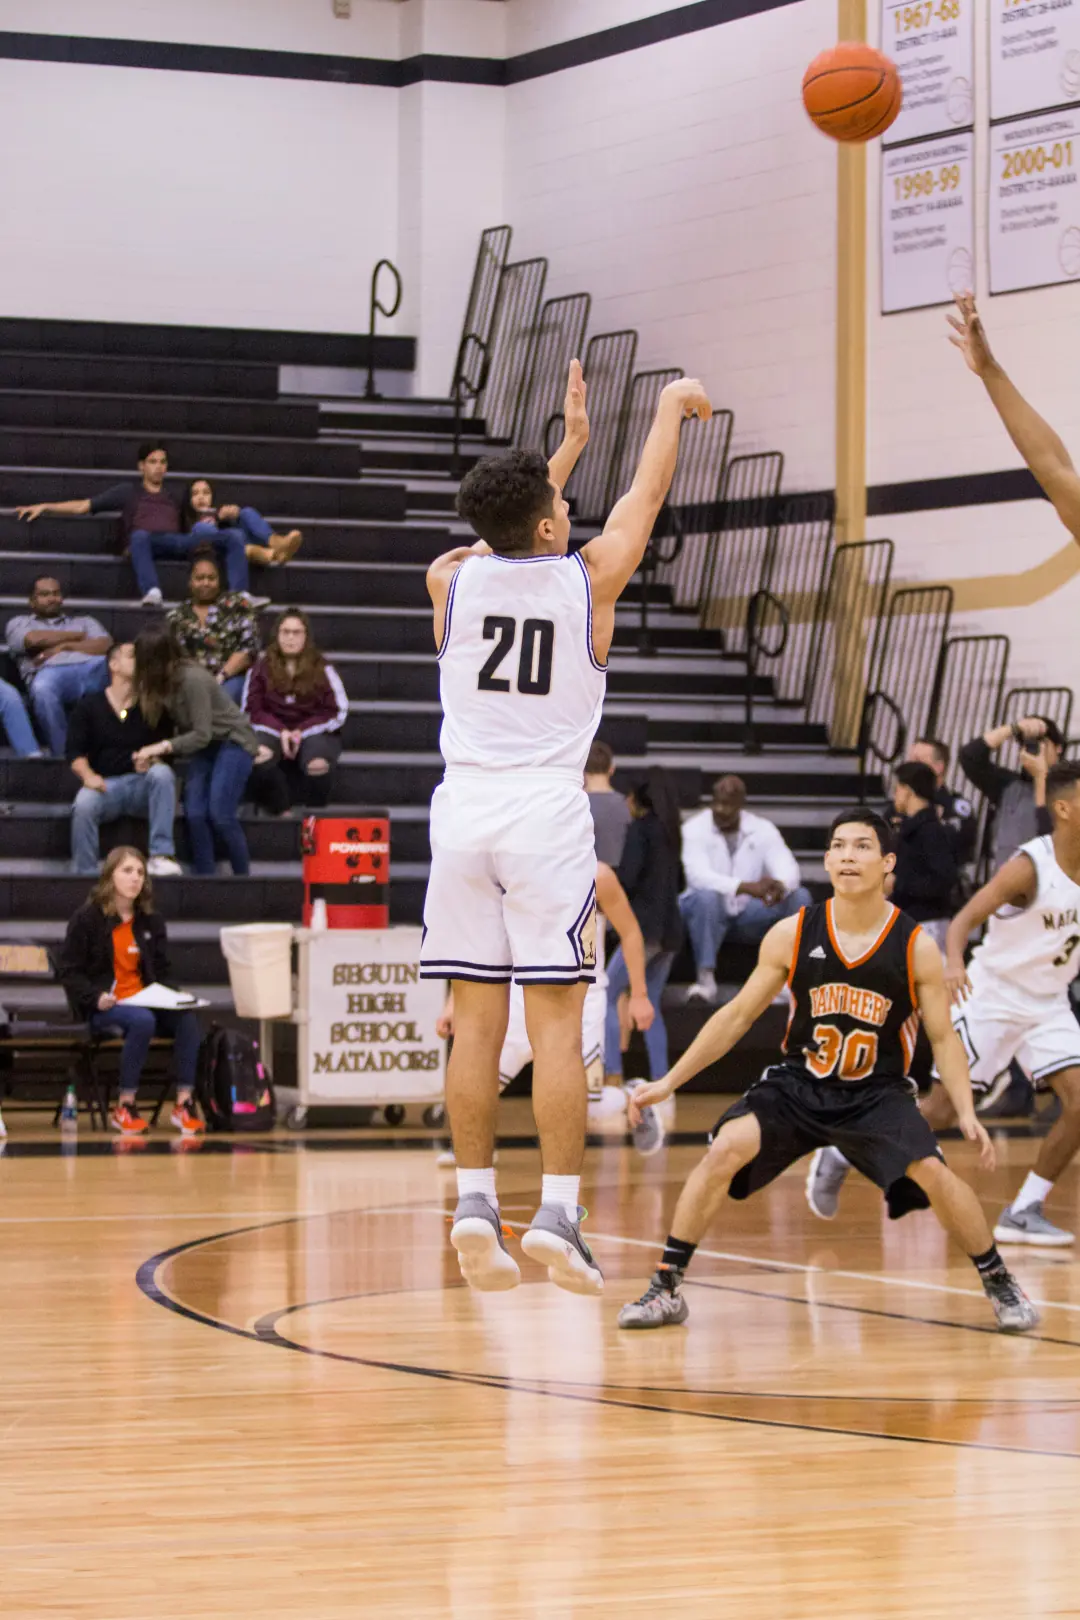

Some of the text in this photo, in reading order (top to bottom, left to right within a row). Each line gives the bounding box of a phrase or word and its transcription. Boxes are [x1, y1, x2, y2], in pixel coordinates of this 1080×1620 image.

[894, 0, 960, 34] 1967-68
[1001, 140, 1073, 180] 2000-01
[894, 164, 960, 201] 1998-99
[477, 615, 555, 696] 20
[1052, 933, 1080, 968] 3
[332, 962, 419, 987] SEGUIN
[346, 991, 407, 1015] HIGH
[330, 1020, 423, 1045] SCHOOL
[312, 1048, 440, 1074] MATADORS
[802, 1023, 878, 1081] 30
